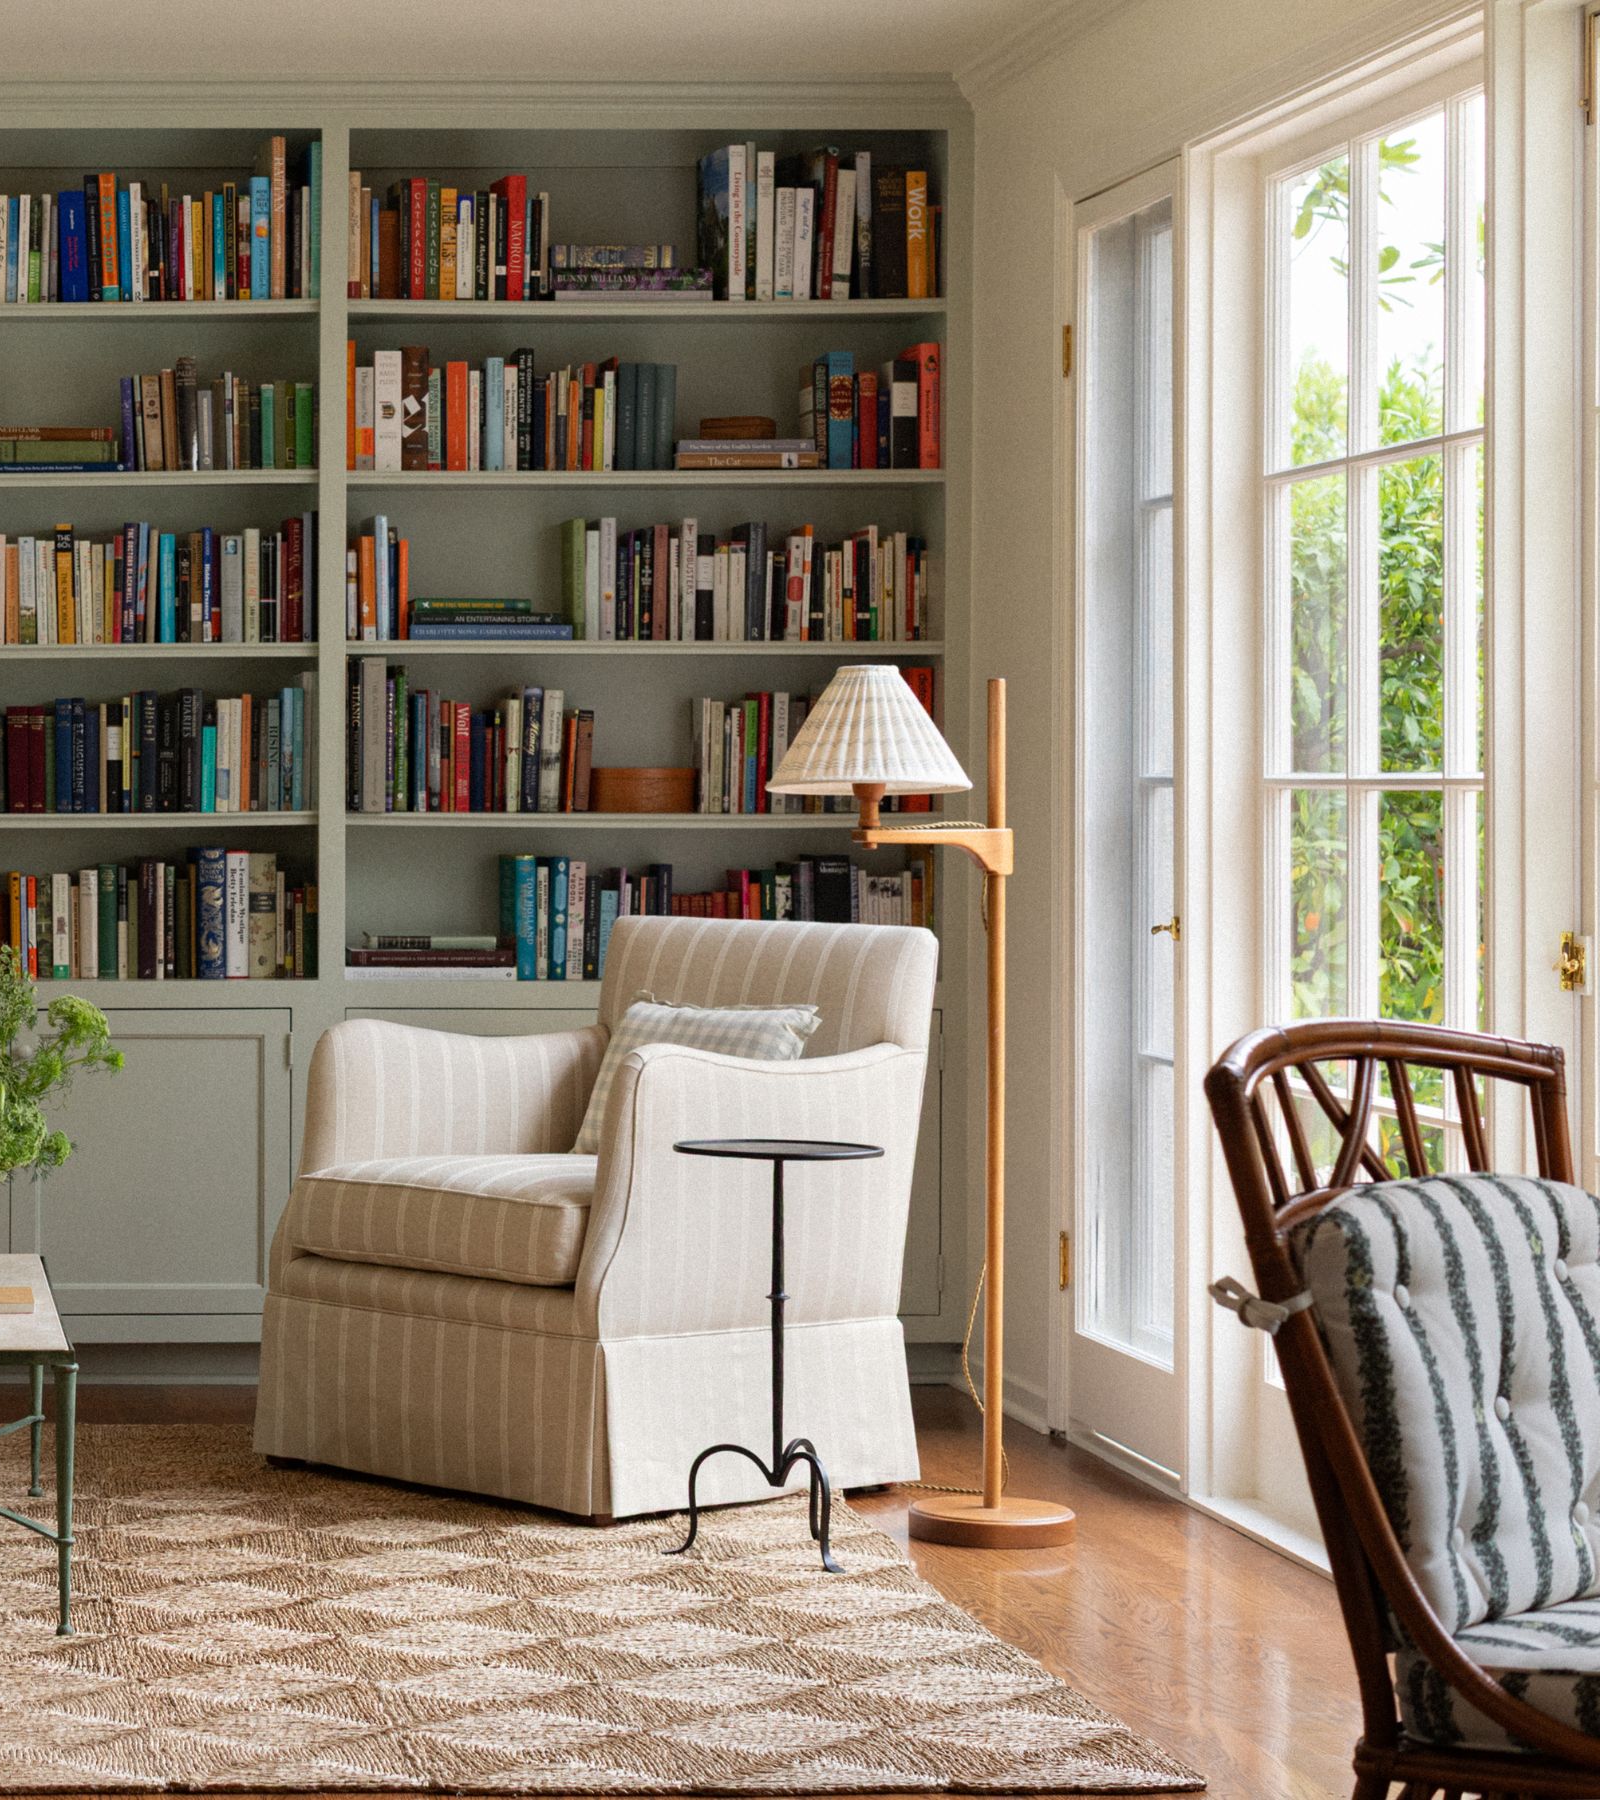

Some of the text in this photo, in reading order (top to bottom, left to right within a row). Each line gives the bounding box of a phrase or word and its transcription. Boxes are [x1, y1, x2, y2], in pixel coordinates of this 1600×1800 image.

[273, 157, 285, 214] RATTAN
[731, 171, 743, 277] Living in the Countryside
[908, 186, 927, 241] Work
[413, 192, 424, 286] CATAFALQUE
[429, 192, 439, 286] CATAFALQUE
[510, 219, 522, 275] NAOROJI
[861, 231, 870, 268] CASTLE
[591, 275, 637, 283] WILLIAMS
[707, 455, 742, 467] The Cat
[126, 527, 135, 538] THE
[292, 523, 300, 567] BELOVED
[126, 569, 135, 604] BLACKWELL
[685, 540, 695, 596] JAMBUSTERS
[415, 628, 455, 636] CHARLOTTE
[508, 628, 557, 636] INSPIRATIONS
[182, 695, 193, 738] DIARIES
[352, 684, 361, 729] TITANIC
[457, 706, 470, 737] Wolf
[777, 700, 786, 739] POEMS
[269, 725, 279, 768] RISING
[524, 716, 542, 756] Money
[76, 739, 84, 795] AUGUSTINE
[229, 868, 238, 925] Betty Friedan
[526, 877, 535, 945] TOM HOLLAND
[569, 873, 577, 908] EUDORA
[236, 908, 245, 945] Mystique
